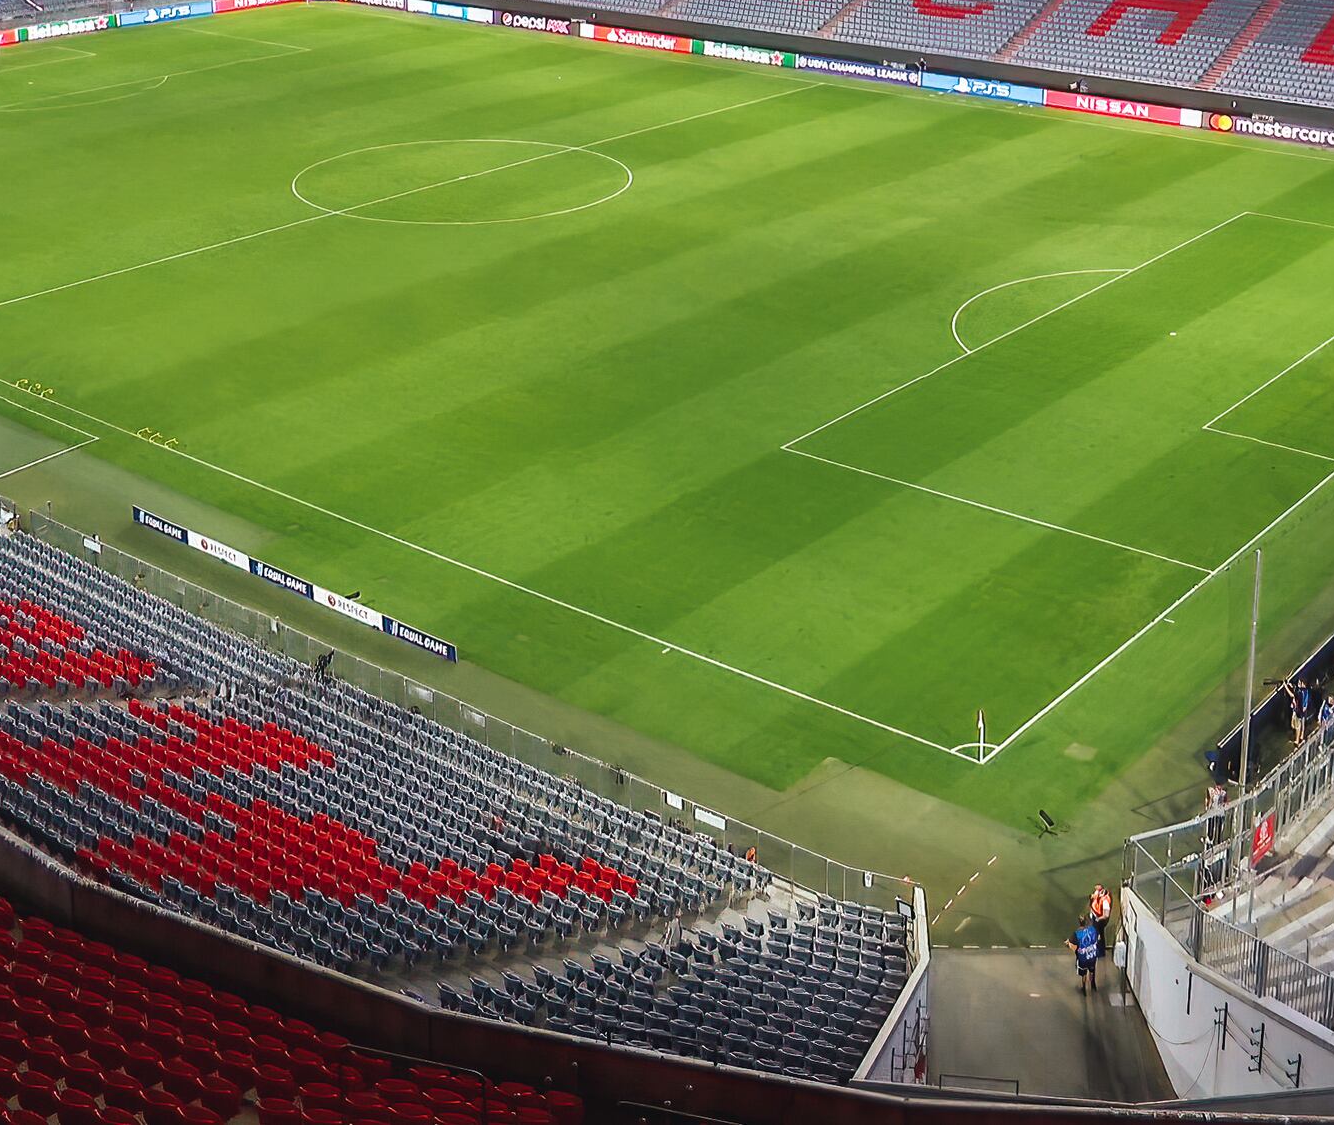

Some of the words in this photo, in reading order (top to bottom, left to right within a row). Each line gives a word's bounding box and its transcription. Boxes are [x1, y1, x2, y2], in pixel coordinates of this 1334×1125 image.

[160, 4, 191, 19] PS5
[514, 14, 546, 30] pepsi
[617, 29, 677, 50] Santander
[704, 39, 770, 64] Heineken
[808, 59, 828, 71] UEFA
[829, 61, 876, 76] CHAMPIONS
[877, 68, 908, 82] LEAGUE
[971, 80, 1010, 97] PS5
[1076, 94, 1149, 118] NISSAN
[145, 514, 164, 532] EQUAL
[163, 523, 182, 540] GAME
[264, 567, 285, 586] EQUAL
[286, 577, 307, 594] GAME
[399, 626, 424, 646] EQUAL
[423, 638, 448, 656] GAME
